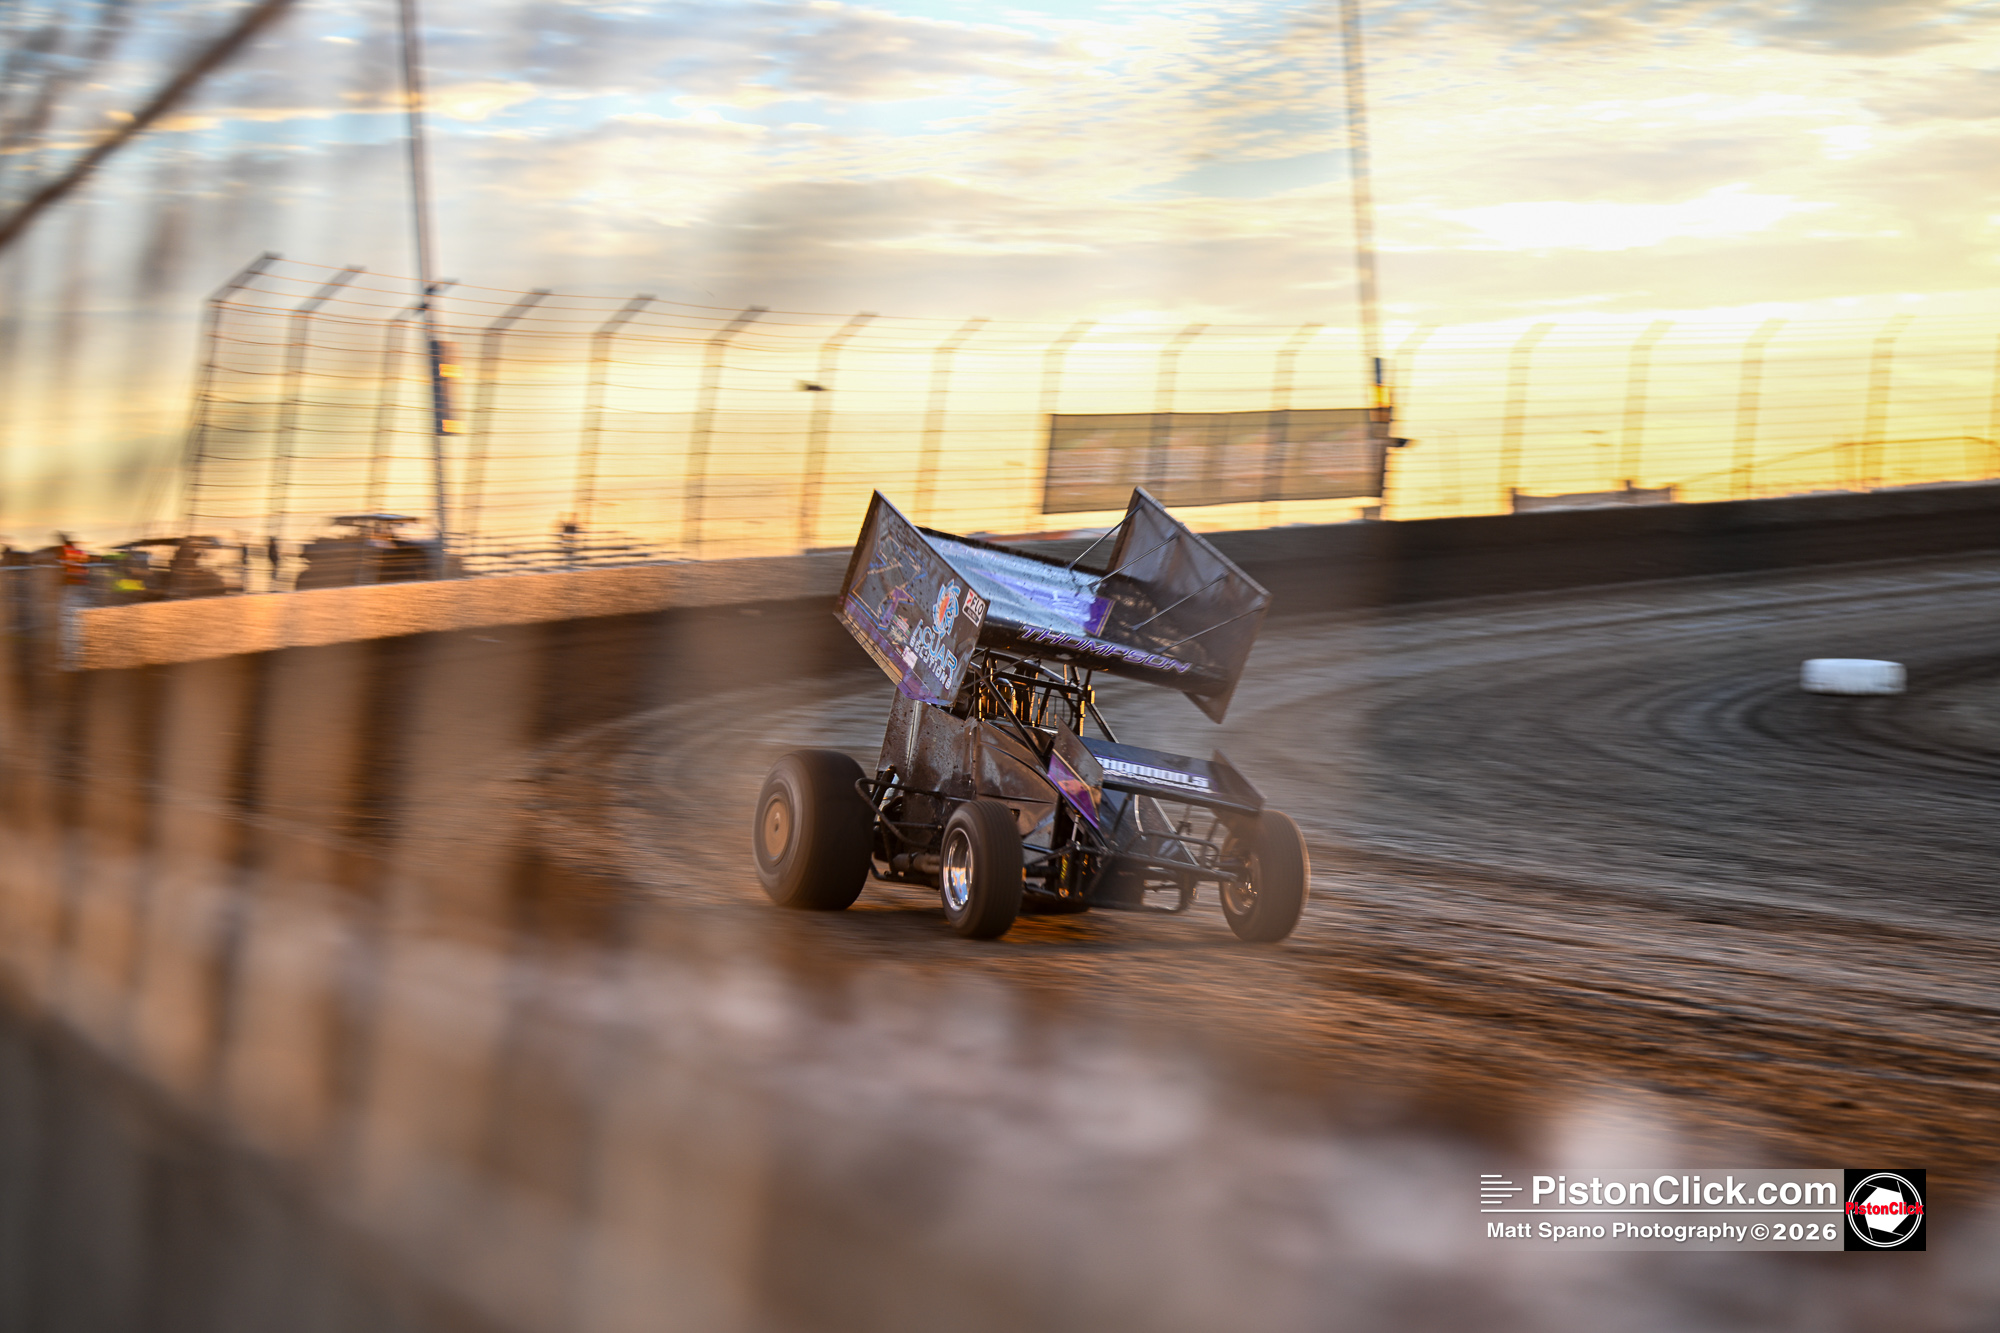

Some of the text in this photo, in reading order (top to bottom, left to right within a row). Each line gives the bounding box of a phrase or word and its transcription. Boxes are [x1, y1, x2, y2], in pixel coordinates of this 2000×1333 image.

[970, 596, 984, 615] FLO
[909, 635, 953, 690] SOLUTIONS
[1018, 625, 1192, 673] THOMPSON
